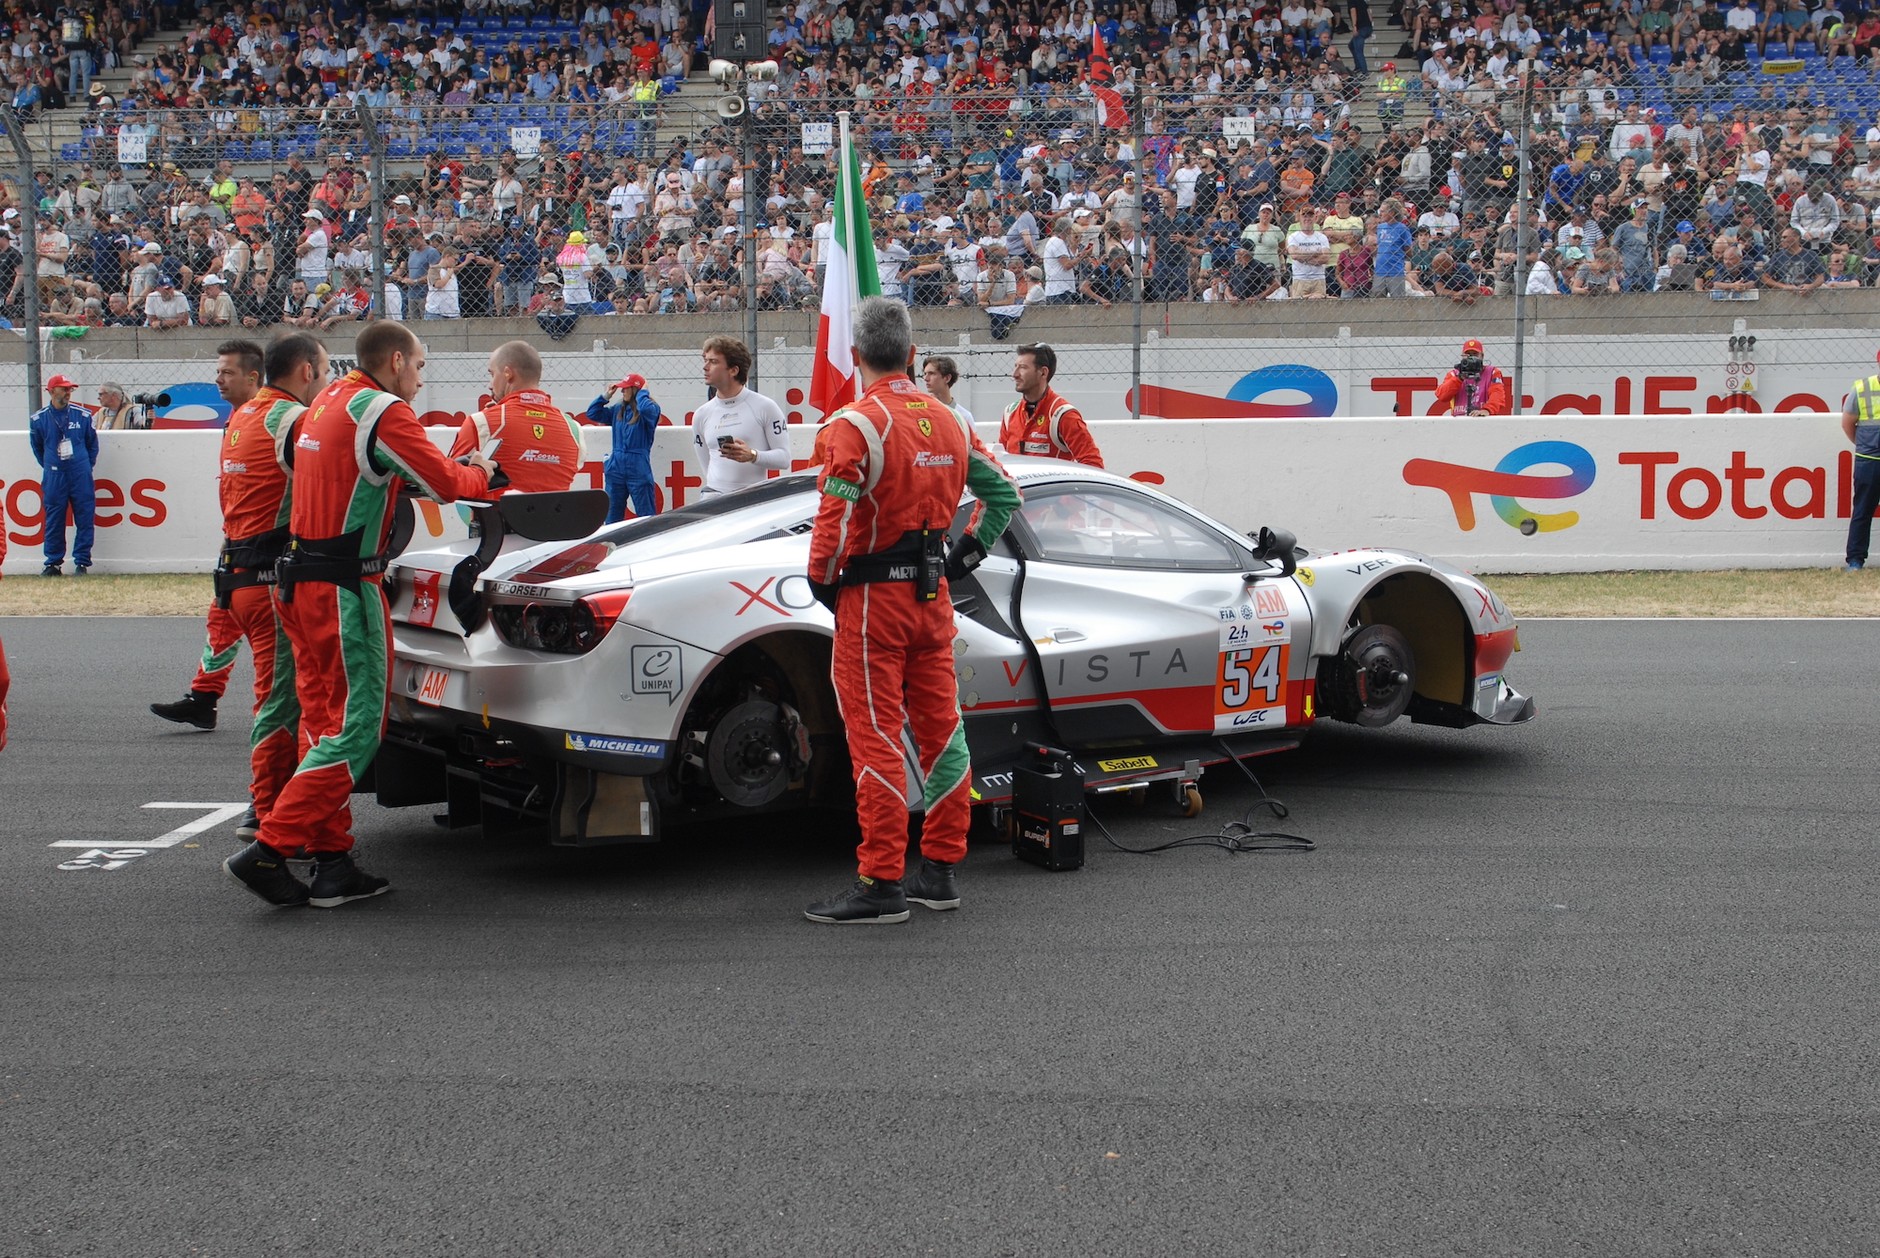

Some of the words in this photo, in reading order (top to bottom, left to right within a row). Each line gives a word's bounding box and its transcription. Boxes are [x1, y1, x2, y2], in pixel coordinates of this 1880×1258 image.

[515, 130, 526, 138] N°
[528, 130, 538, 138] 47
[805, 124, 816, 133] N°
[817, 124, 828, 133] 47
[134, 136, 144, 144] 23
[1618, 450, 1859, 520] Total
[0, 478, 167, 547] ges
[491, 582, 551, 597] AFCORSE.IT
[1255, 589, 1285, 614] AM
[1002, 647, 1189, 688] VISTA
[641, 679, 674, 690] UNIPAY
[1222, 645, 1282, 708] 54
[421, 670, 448, 701] AM
[1233, 709, 1268, 726] WEC
[588, 739, 661, 754] MICHELIN
[1105, 757, 1151, 771] Sabelt
